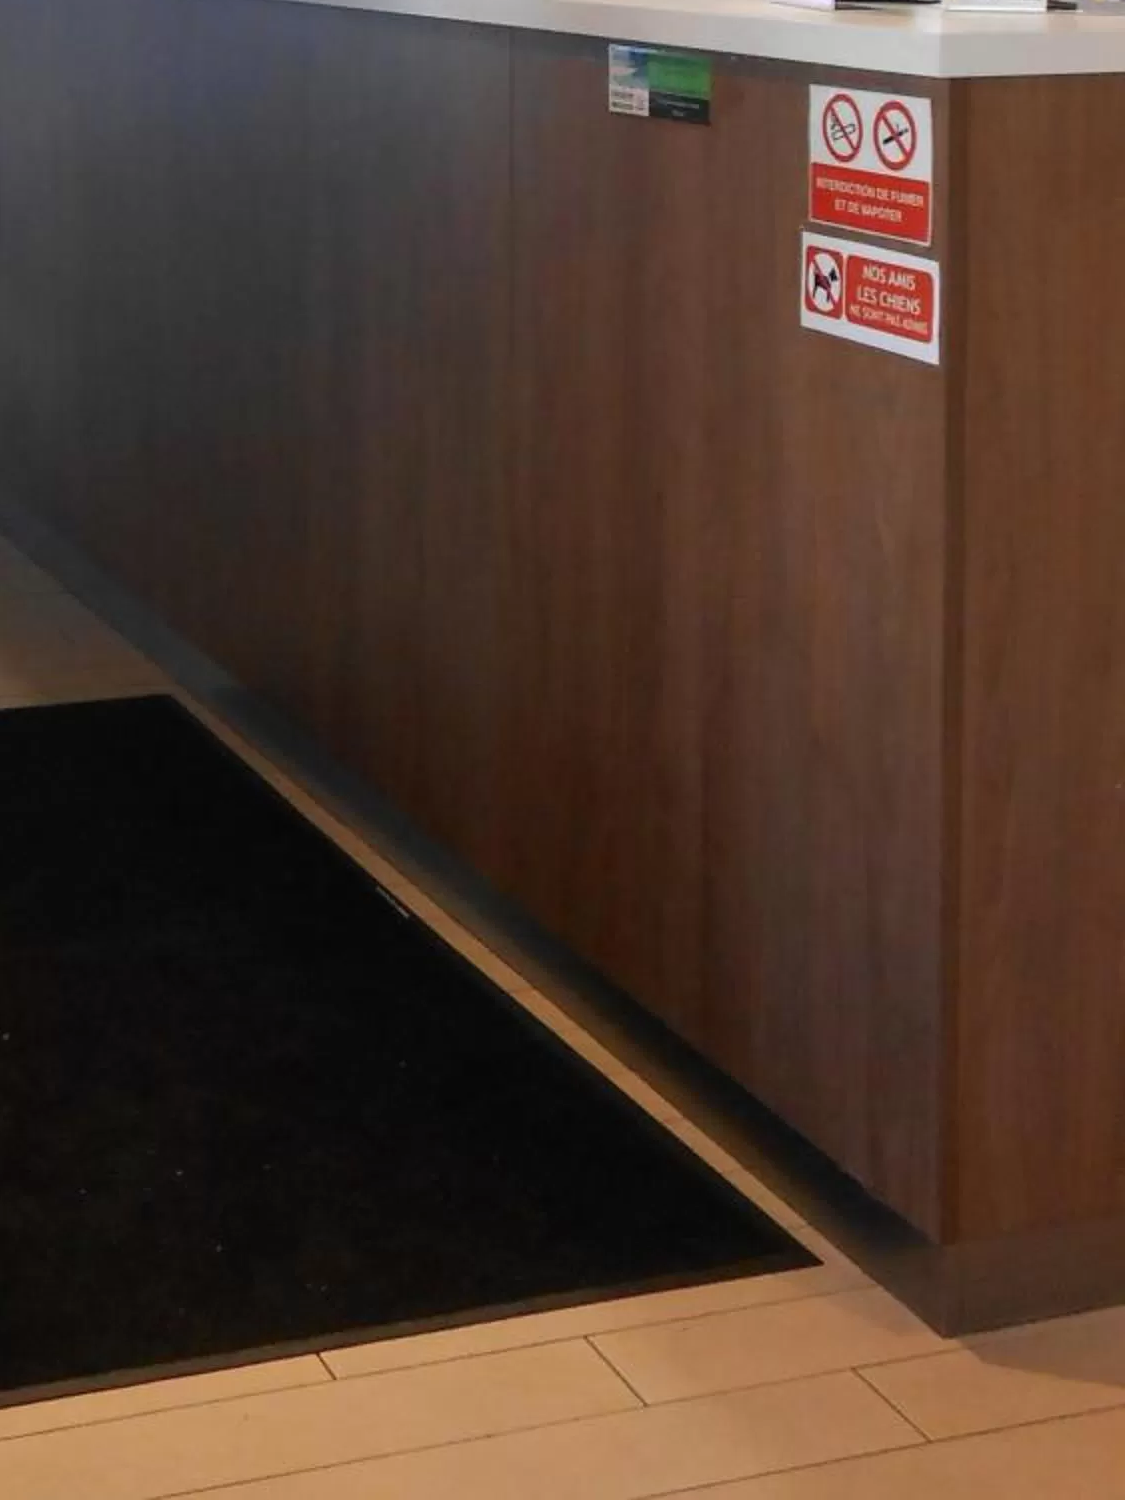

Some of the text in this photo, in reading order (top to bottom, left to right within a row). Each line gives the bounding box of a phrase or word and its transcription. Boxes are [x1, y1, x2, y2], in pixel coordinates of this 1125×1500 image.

[816, 177, 924, 208] INTERDICTION DE FUMER
[834, 198, 847, 211] ET
[847, 201, 860, 214] DE
[862, 263, 916, 291] NOS AMIS
[856, 284, 921, 316] LES CHIENS
